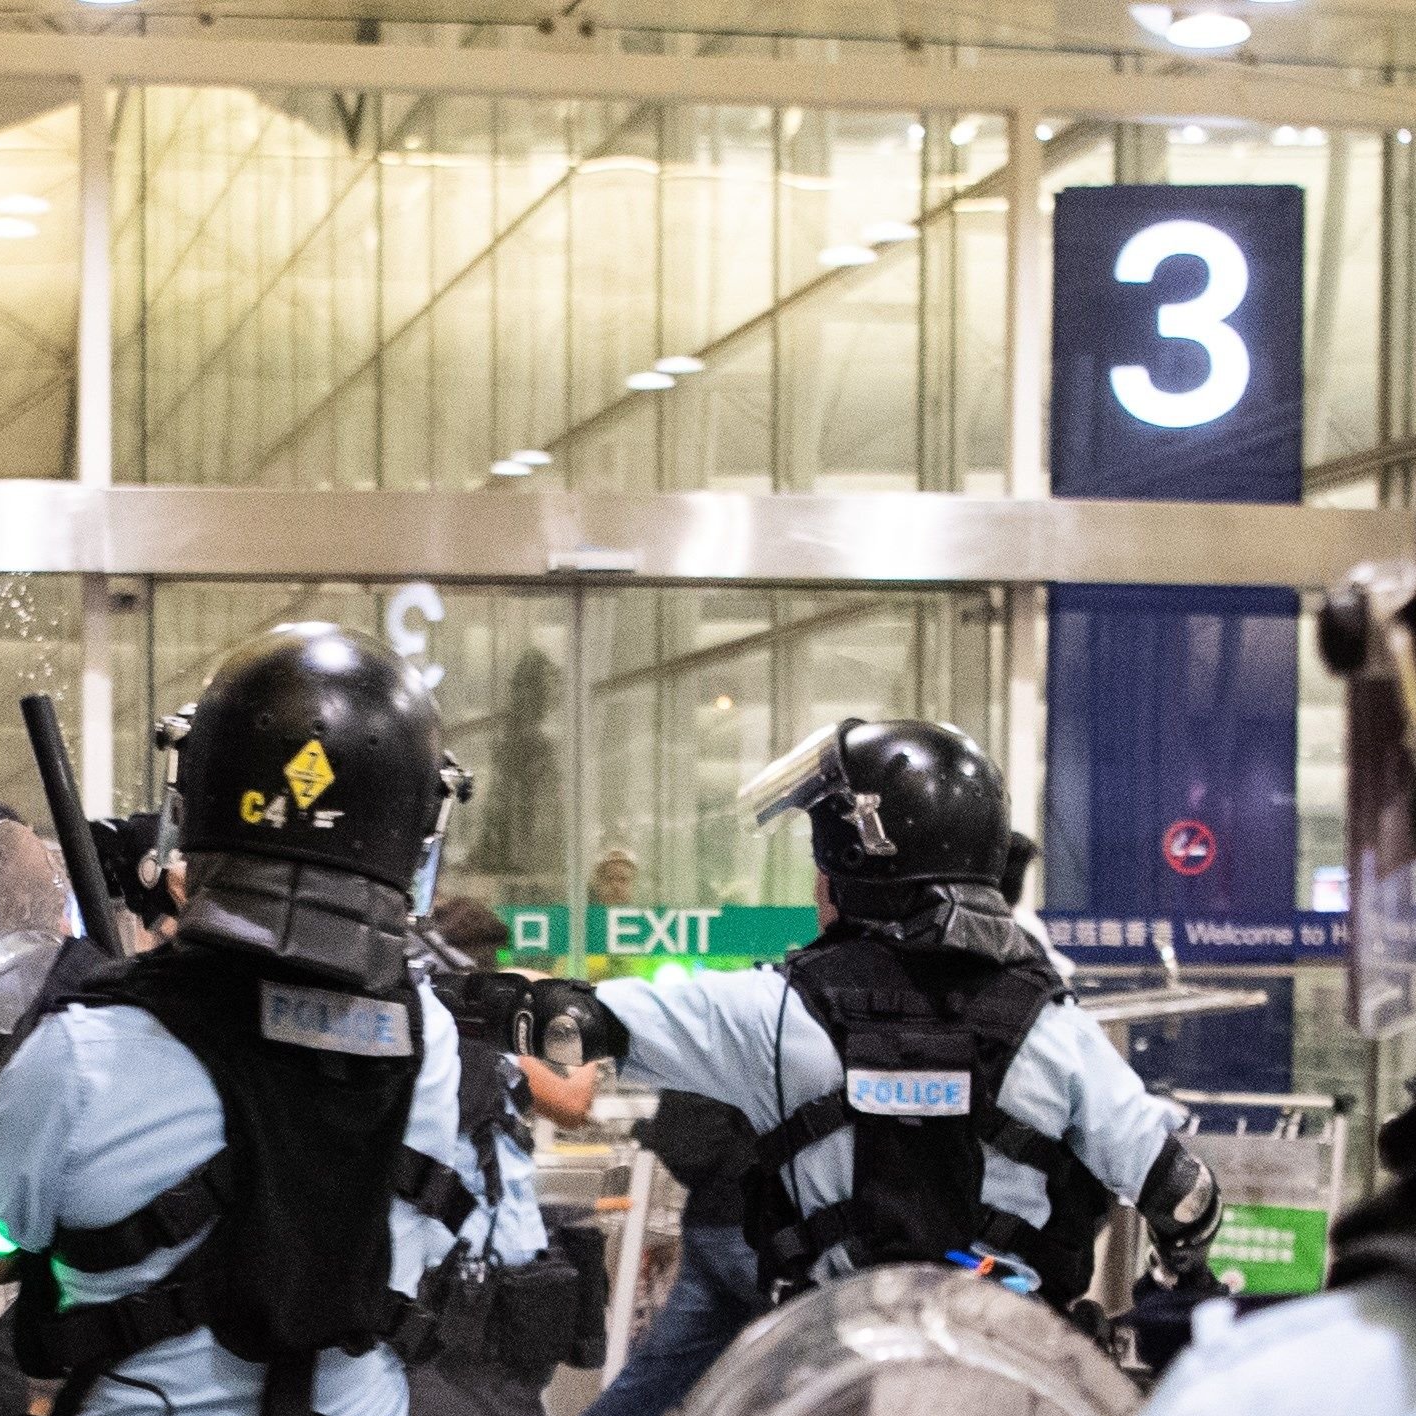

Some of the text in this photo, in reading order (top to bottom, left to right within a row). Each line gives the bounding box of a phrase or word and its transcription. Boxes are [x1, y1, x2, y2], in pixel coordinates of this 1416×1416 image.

[1108, 219, 1251, 428] 3
[239, 790, 287, 829] C4
[607, 907, 723, 954] EXIT
[1185, 922, 1293, 946] Welcome
[1300, 923, 1325, 946] to
[855, 1079, 961, 1106] POLICE
